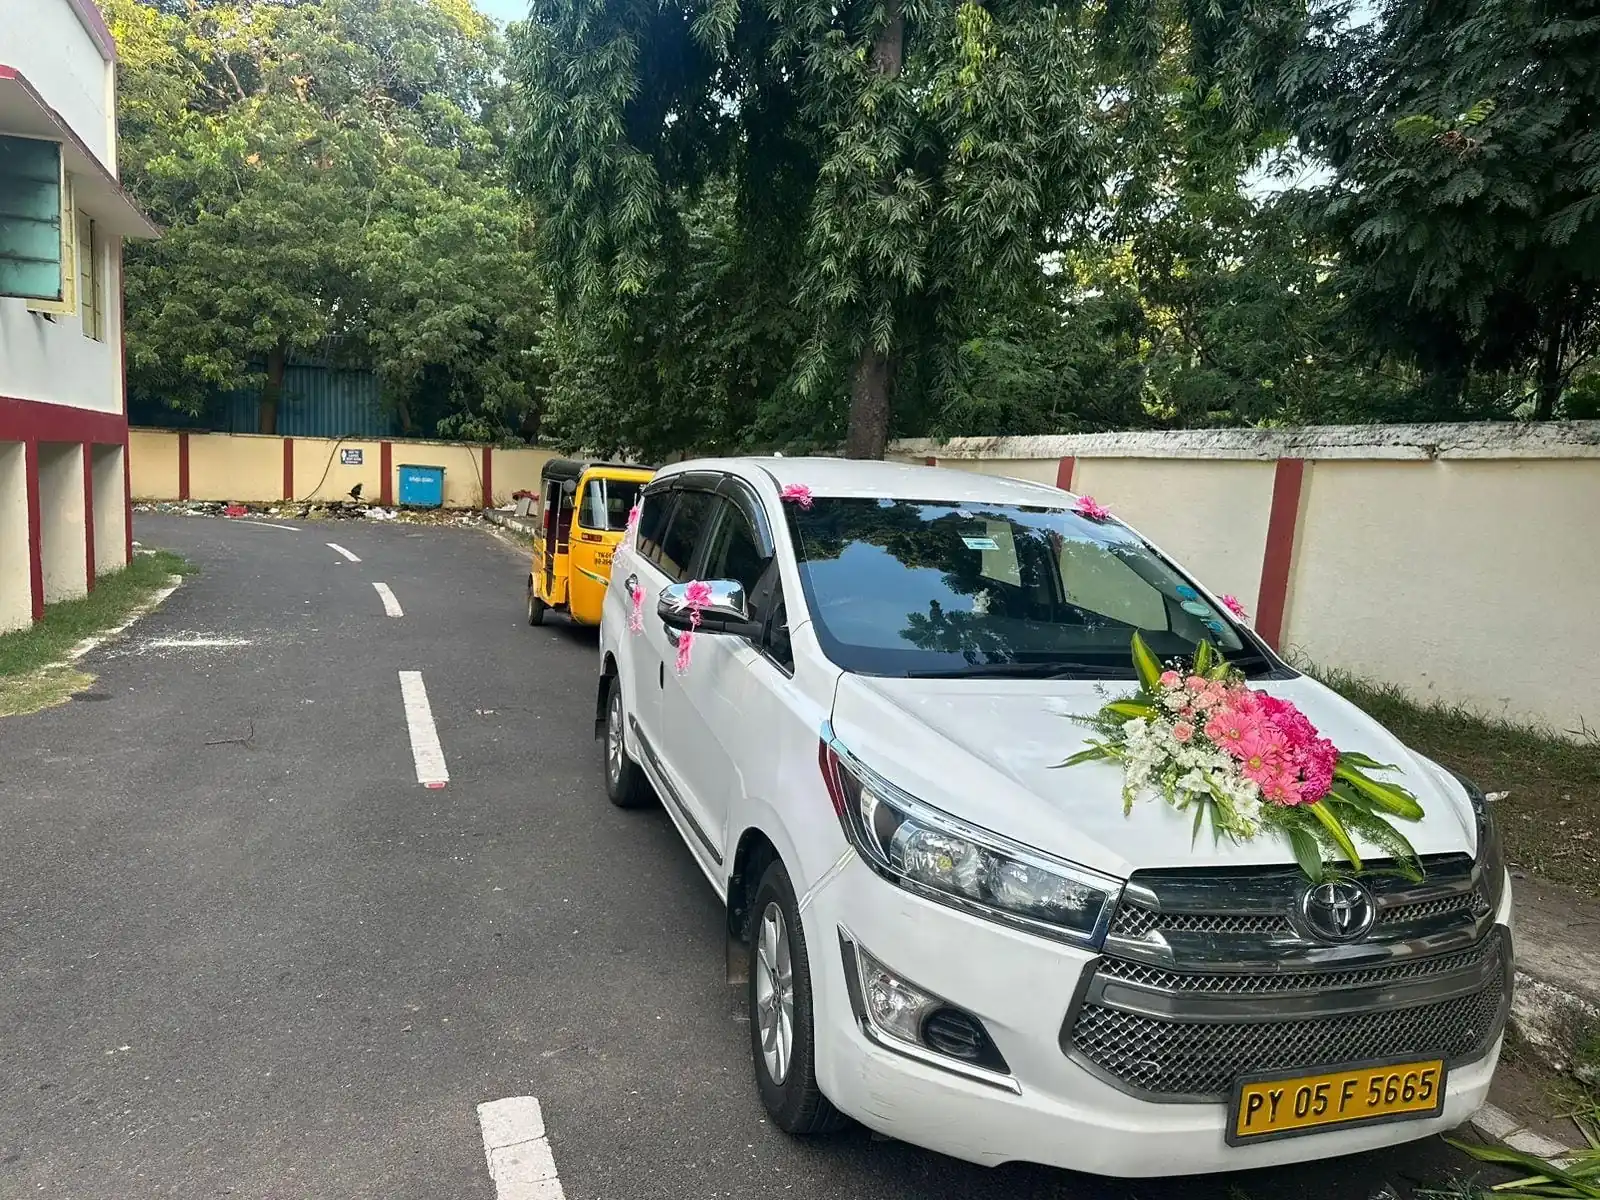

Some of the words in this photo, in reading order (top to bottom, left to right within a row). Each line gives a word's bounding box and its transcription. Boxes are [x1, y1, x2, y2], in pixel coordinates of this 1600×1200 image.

[1244, 1088, 1284, 1126] PY
[1293, 1082, 1331, 1118] 05
[1337, 1079, 1358, 1112] F
[1366, 1068, 1436, 1108] 5665
